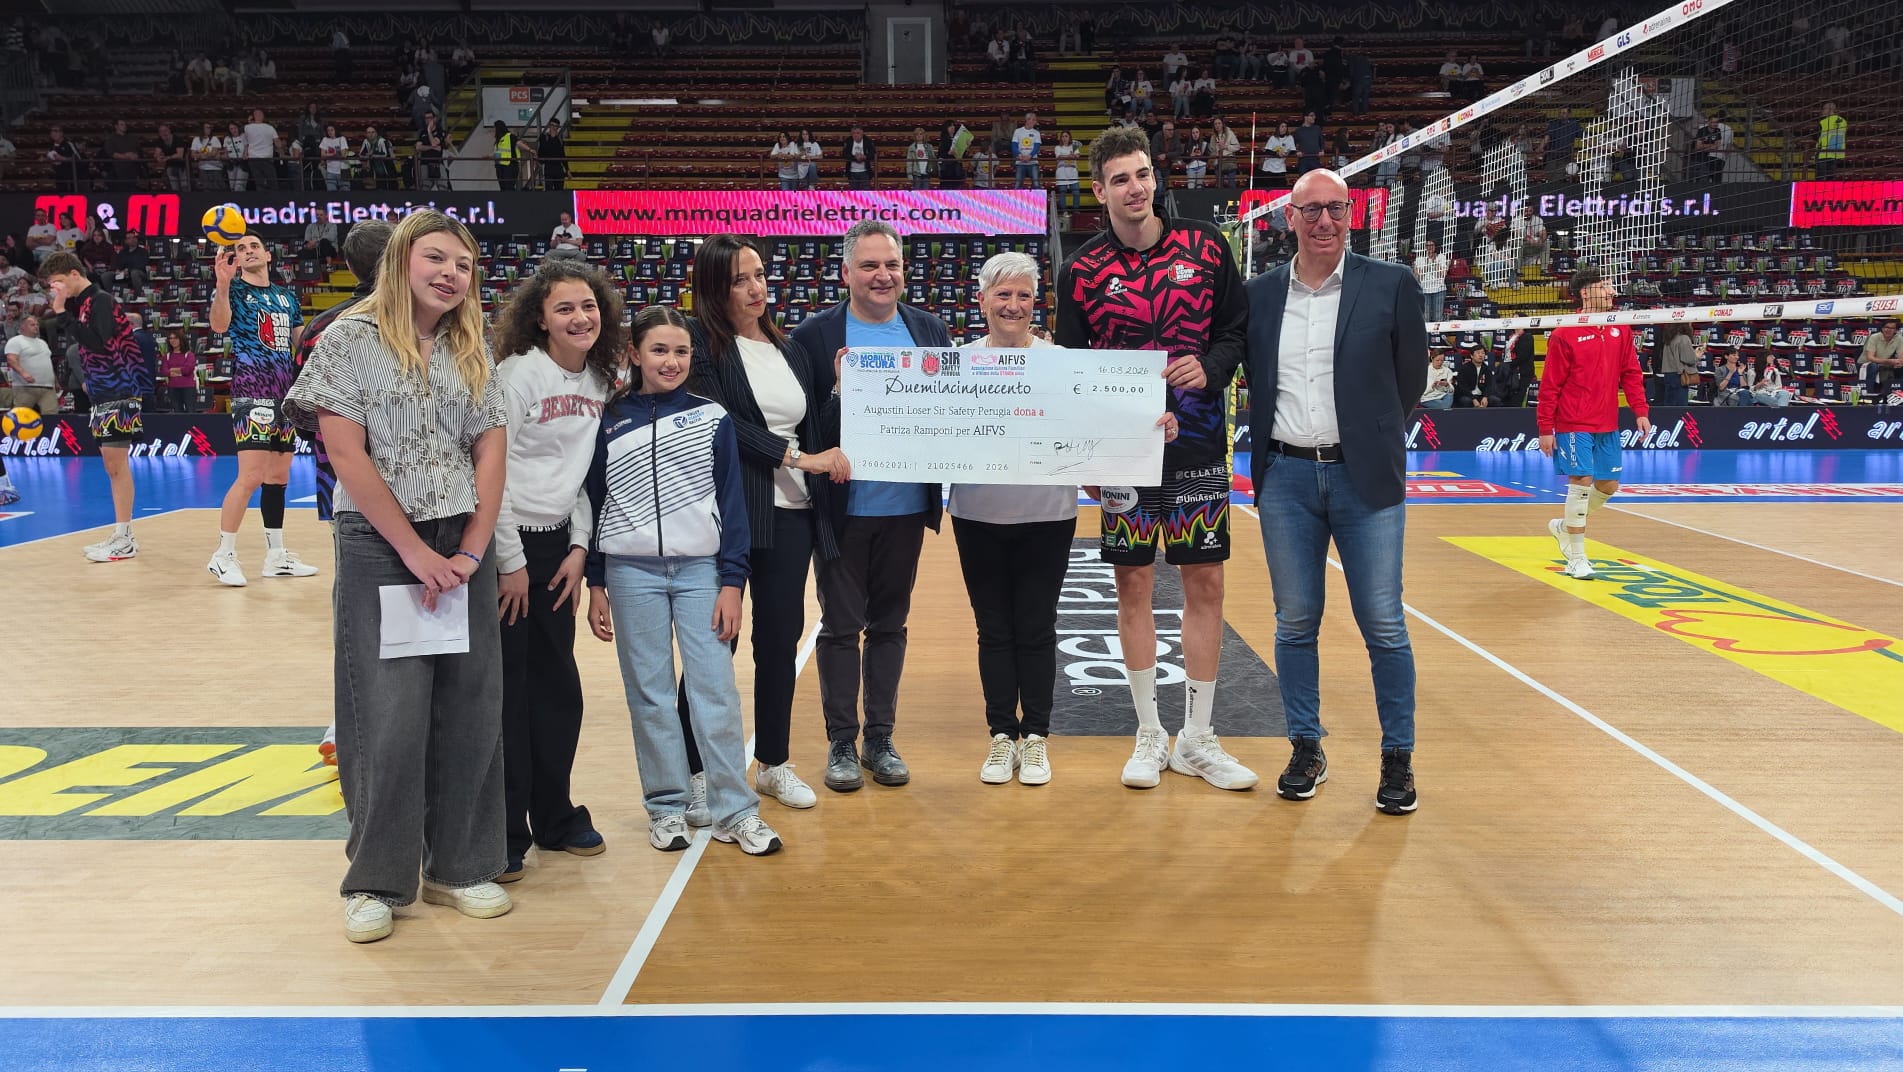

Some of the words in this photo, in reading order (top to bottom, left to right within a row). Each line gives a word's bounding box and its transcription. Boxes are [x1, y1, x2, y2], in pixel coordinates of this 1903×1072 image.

[1616, 32, 1631, 48] GLS
[511, 89, 528, 99] PCS
[586, 203, 962, 222] www.mmquadrielettrici.com
[1872, 299, 1898, 311] SUSA
[1712, 308, 1734, 318] CONAD
[271, 312, 289, 327] SIR
[274, 337, 289, 347] SCA
[941, 352, 961, 364] SIR
[998, 354, 1026, 366] AIFVS
[860, 360, 896, 369] SICURA
[885, 375, 1031, 399] Duemilacinquecento
[1073, 383, 1081, 395] €
[1092, 385, 1144, 394] 2.500,00
[864, 405, 904, 417] Augustin
[907, 405, 931, 415] Loser
[933, 406, 945, 415] Sir
[949, 406, 975, 418] Safety
[978, 407, 1011, 418] Perugia
[1013, 407, 1036, 416] dona
[914, 425, 953, 436] Ramponi
[956, 427, 970, 437] per
[973, 425, 1006, 436] AIFVS
[927, 462, 974, 471] 21025466
[985, 463, 1009, 471] 2026
